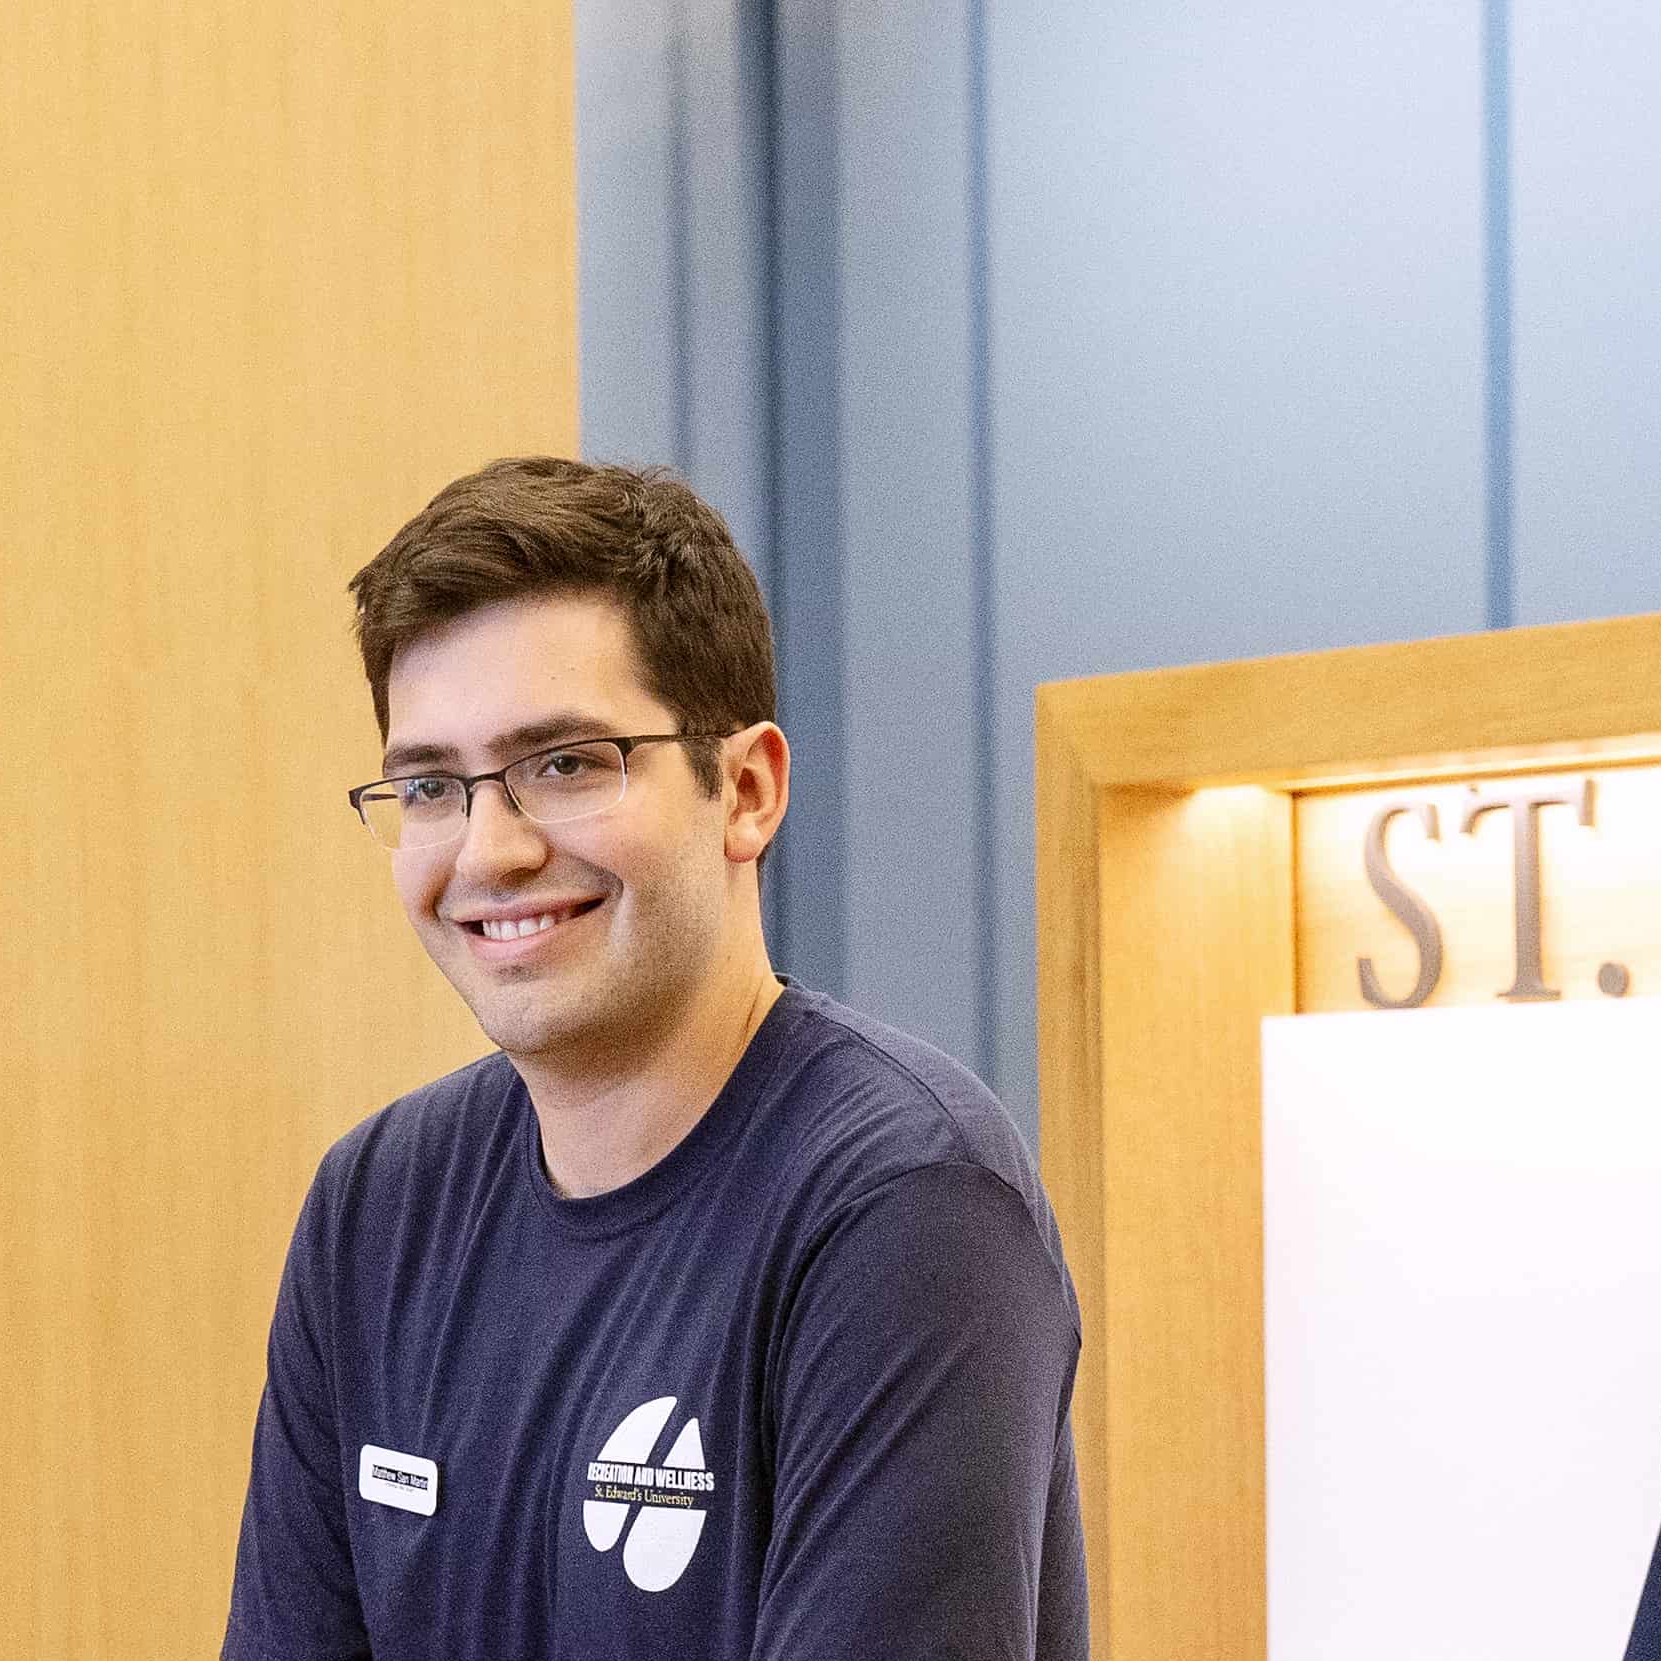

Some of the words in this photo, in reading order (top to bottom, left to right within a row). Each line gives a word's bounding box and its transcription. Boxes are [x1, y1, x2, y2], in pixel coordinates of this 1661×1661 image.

[1356, 777, 1631, 1010] ST.
[634, 1466, 655, 1487] AND
[655, 1468, 716, 1491] WELLNESS
[643, 1487, 695, 1510] University
